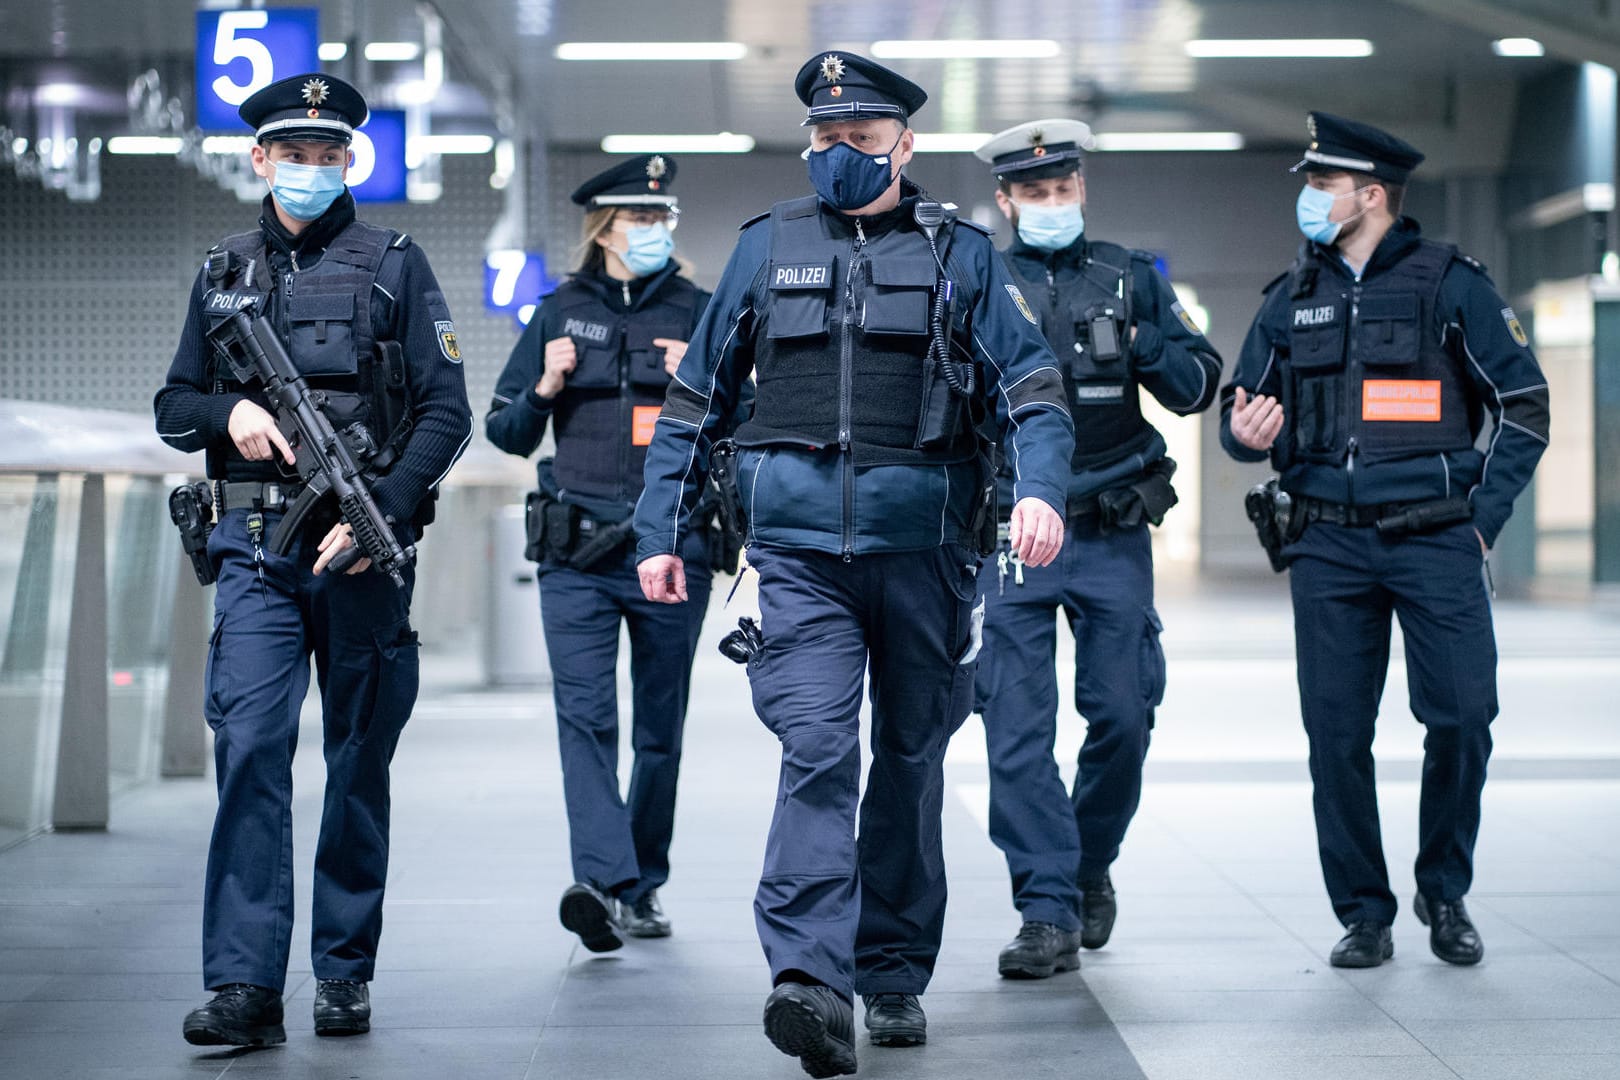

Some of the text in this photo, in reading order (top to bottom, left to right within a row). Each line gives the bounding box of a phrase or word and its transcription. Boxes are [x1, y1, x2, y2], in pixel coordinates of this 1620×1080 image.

[212, 10, 274, 106] 5
[487, 250, 527, 307] 7
[776, 266, 826, 285] POLIZEI
[1294, 305, 1335, 326] POLIZEI
[564, 318, 609, 341] POLIZEI
